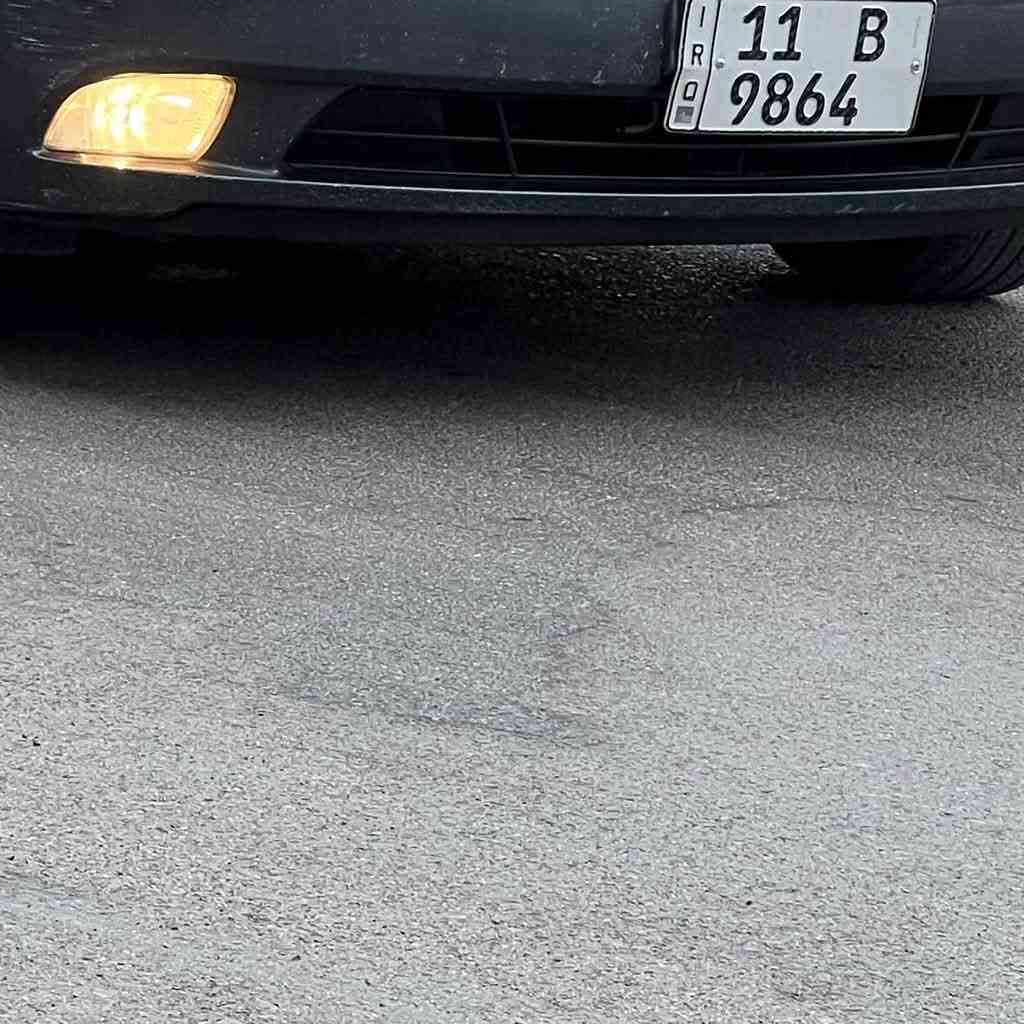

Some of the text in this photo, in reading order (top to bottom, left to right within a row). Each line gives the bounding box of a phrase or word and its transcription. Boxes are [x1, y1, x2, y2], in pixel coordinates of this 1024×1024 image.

[738, 5, 888, 62] 11 B
[730, 72, 858, 126] 9864
